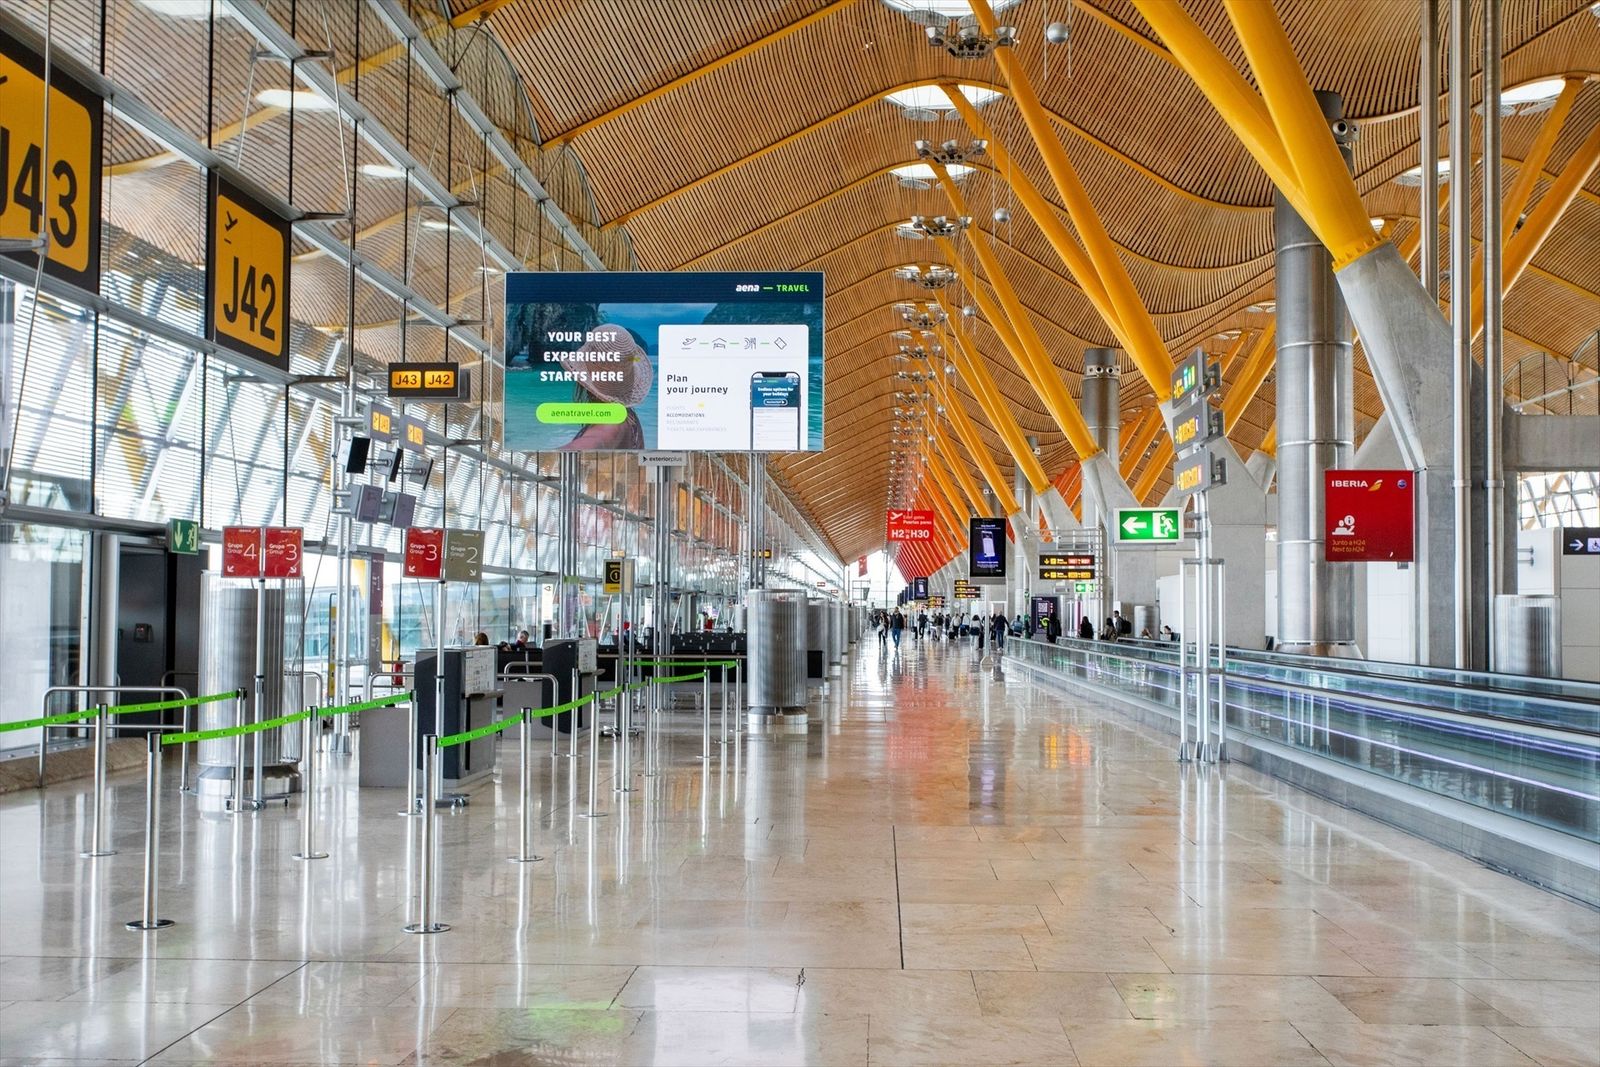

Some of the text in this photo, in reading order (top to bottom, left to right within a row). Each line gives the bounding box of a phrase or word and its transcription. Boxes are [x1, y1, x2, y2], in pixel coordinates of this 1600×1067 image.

[736, 284, 810, 292] aena TRAVEL
[223, 256, 276, 342] J42
[548, 331, 617, 342] YOUR BEST
[543, 351, 621, 362] EXPERIENCE
[395, 374, 450, 385] J43 J42
[540, 371, 624, 382] STARTS HERE
[667, 374, 688, 382] Plan
[667, 385, 728, 395] your journey
[551, 409, 612, 417] aenatravel.com
[1331, 480, 1369, 488] IBERIA
[891, 530, 904, 538] H2
[911, 530, 930, 538] H30
[243, 543, 257, 560] 4
[285, 543, 298, 561] 3
[425, 544, 438, 561] 3
[466, 546, 478, 564] 2
